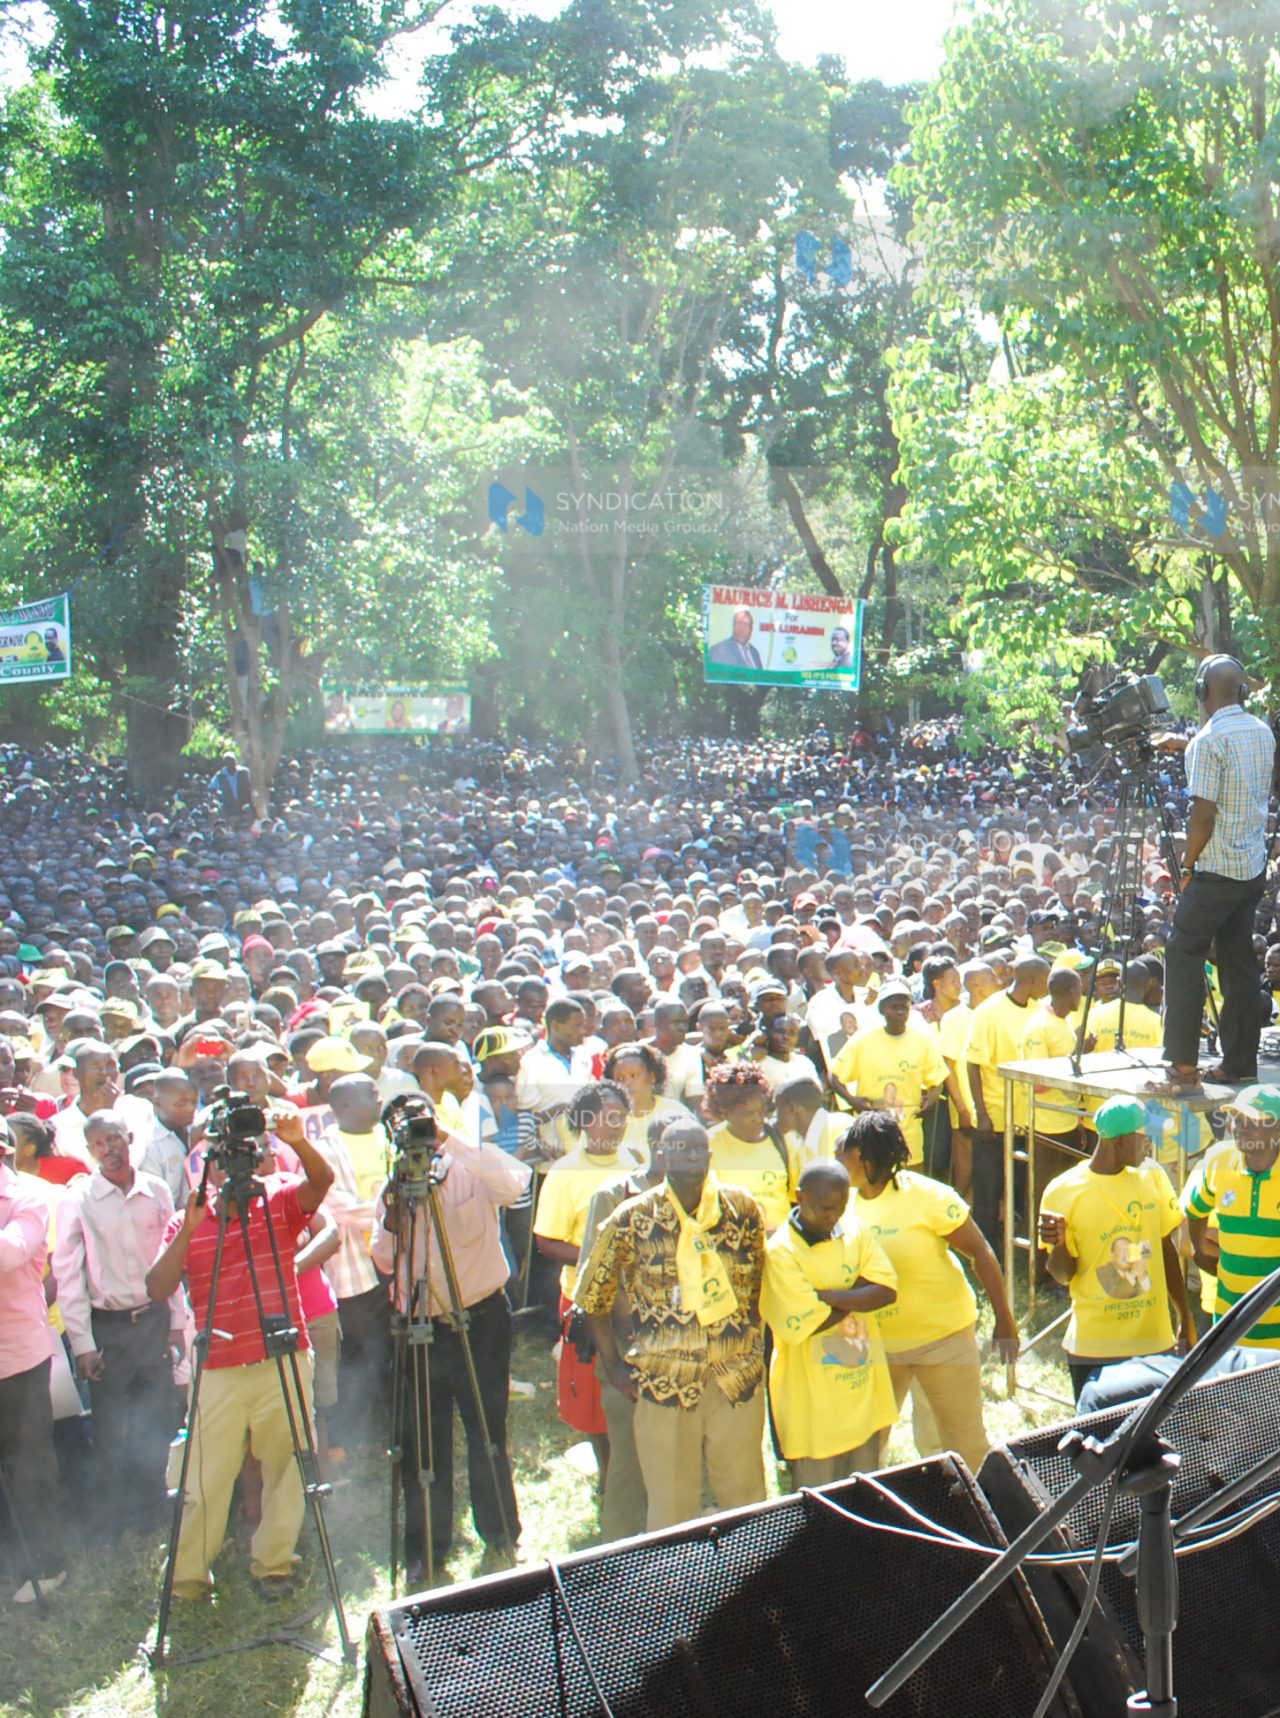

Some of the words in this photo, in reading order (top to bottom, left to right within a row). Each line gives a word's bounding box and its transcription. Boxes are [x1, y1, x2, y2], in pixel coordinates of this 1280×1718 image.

[712, 587, 773, 609] MAURICE
[775, 591, 788, 610] M.
[792, 593, 854, 615] LISHENGA
[785, 613, 799, 622] For
[0, 664, 56, 676] County
[883, 1228, 899, 1236] UDF
[1104, 1298, 1157, 1312] PRESIDENT
[1117, 1309, 1141, 1320] 2013
